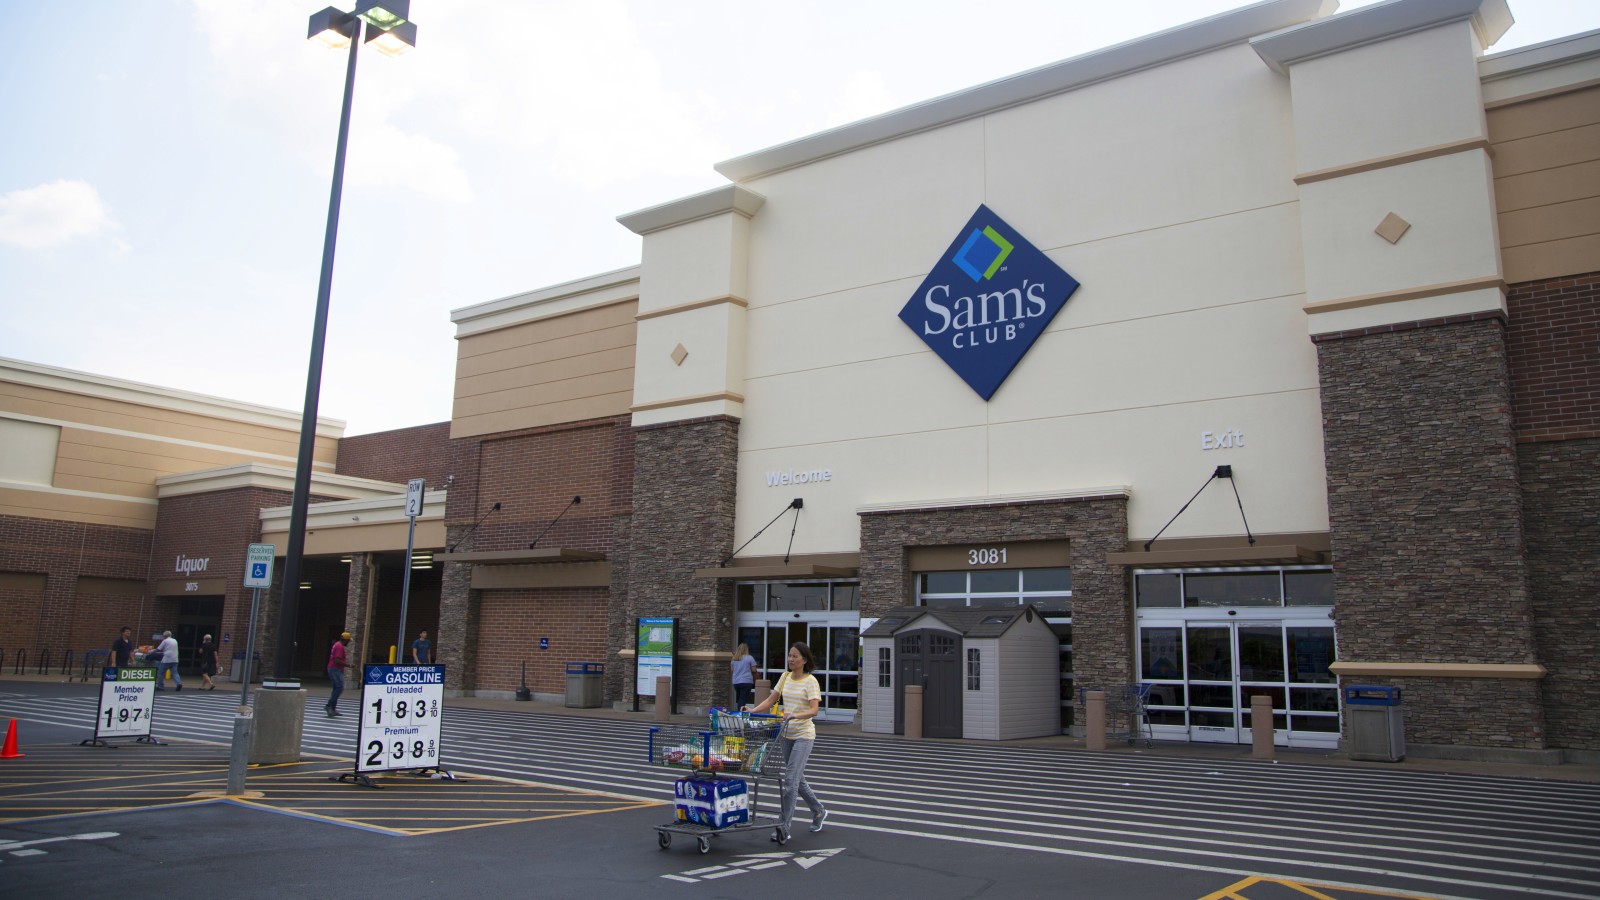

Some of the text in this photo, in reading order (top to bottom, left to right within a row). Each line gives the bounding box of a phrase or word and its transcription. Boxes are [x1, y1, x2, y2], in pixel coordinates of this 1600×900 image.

[925, 279, 1046, 335] Sam's
[1202, 428, 1245, 450] Exit
[766, 467, 832, 487] Welcome
[410, 499, 416, 512] 2
[968, 548, 1007, 564] 3081
[175, 554, 209, 576] Liquor
[121, 669, 155, 679] DIESEL
[385, 673, 441, 683] GASOLINE
[386, 686, 423, 694] Unleaded
[119, 694, 138, 702] Price
